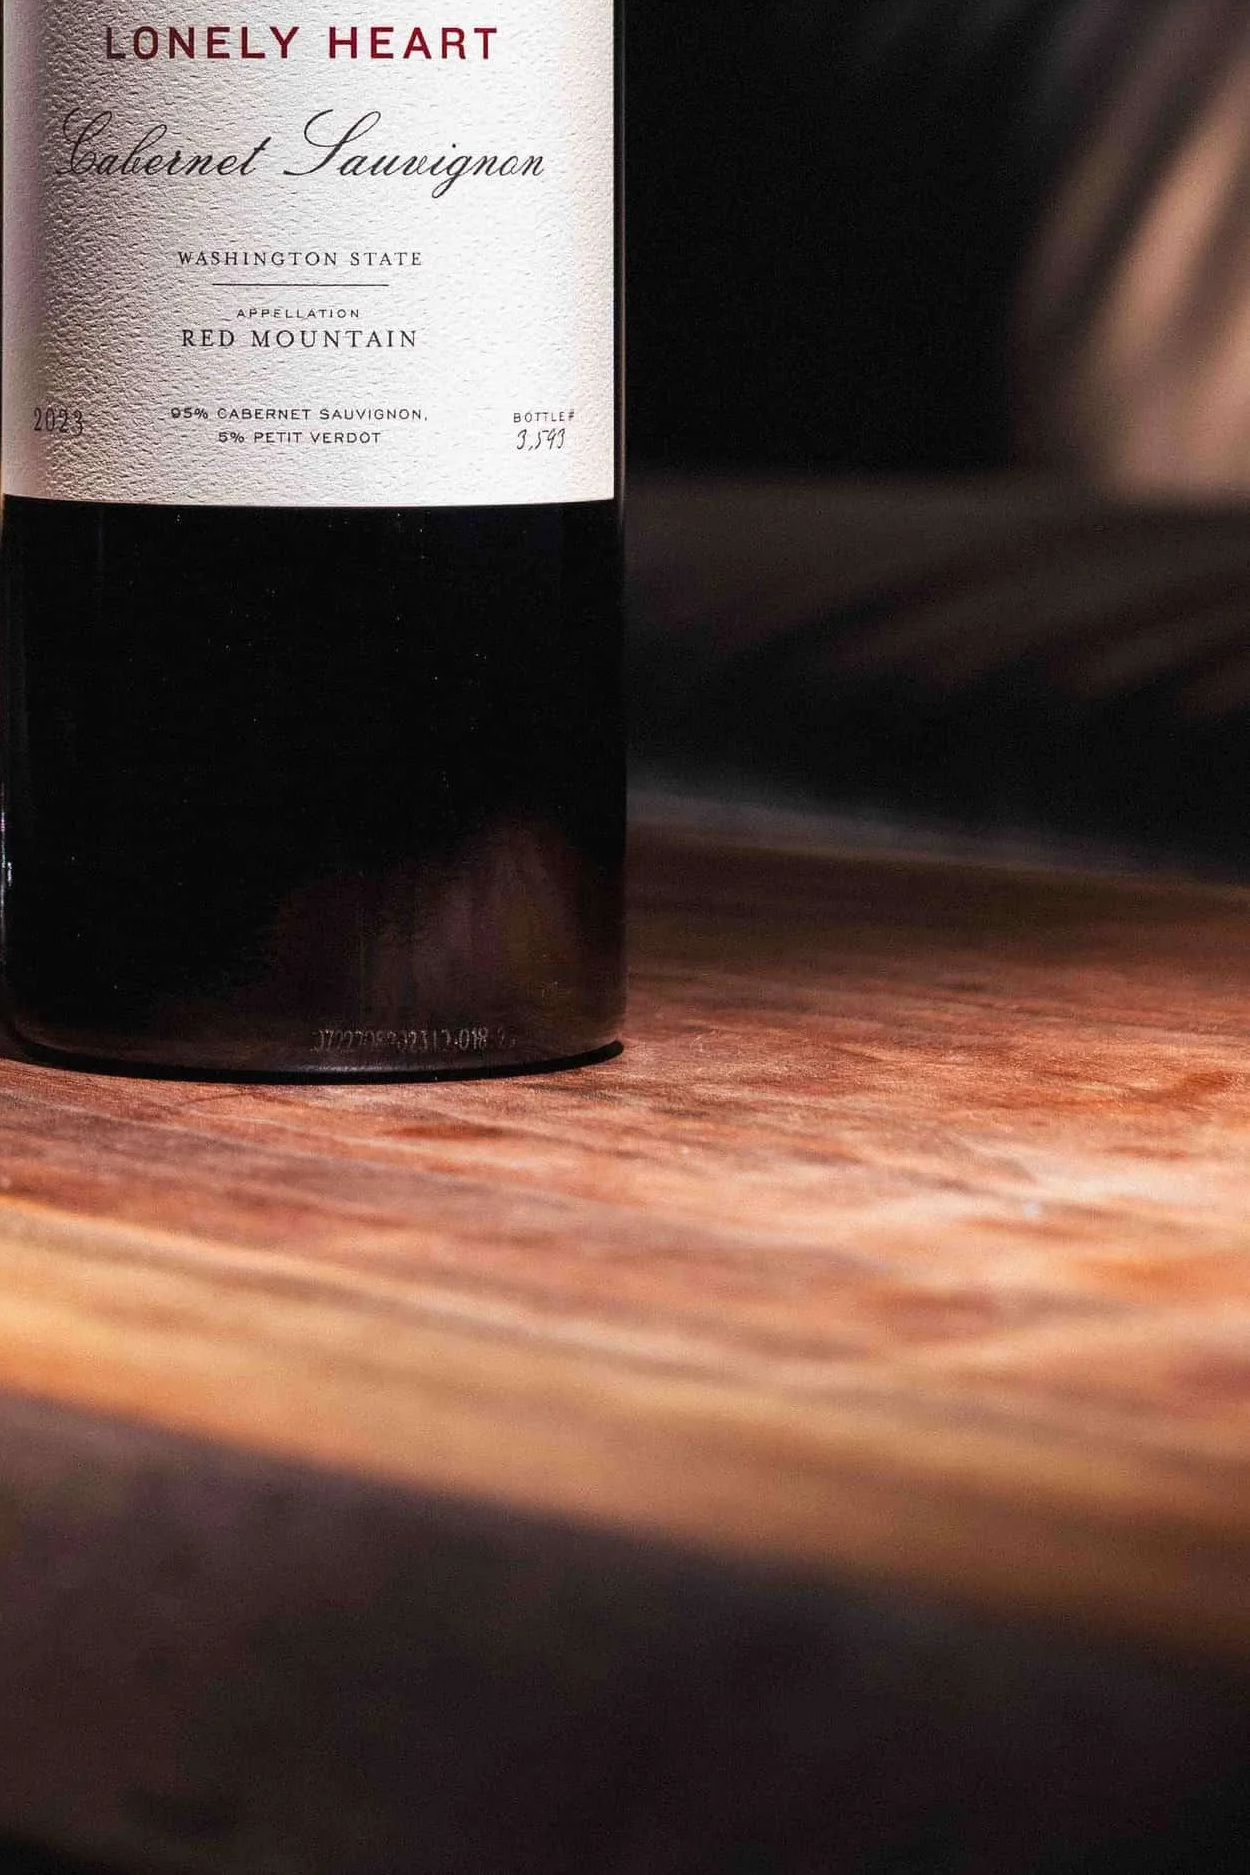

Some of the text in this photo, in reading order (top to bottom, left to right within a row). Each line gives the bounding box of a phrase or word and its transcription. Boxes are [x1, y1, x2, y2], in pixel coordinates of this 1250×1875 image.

[105, 26, 498, 61] LONELY HEART
[58, 107, 545, 199] Cabernet Sauvignon
[177, 250, 423, 267] WASHINGTON STATE
[236, 308, 361, 319] APPELLATION
[181, 329, 419, 349] RED MOUNTAIN
[33, 406, 84, 437] 2023
[170, 407, 429, 422] 95% CABERNET SAUVIGNON,
[218, 431, 382, 445] 5% PETIT VERDOT
